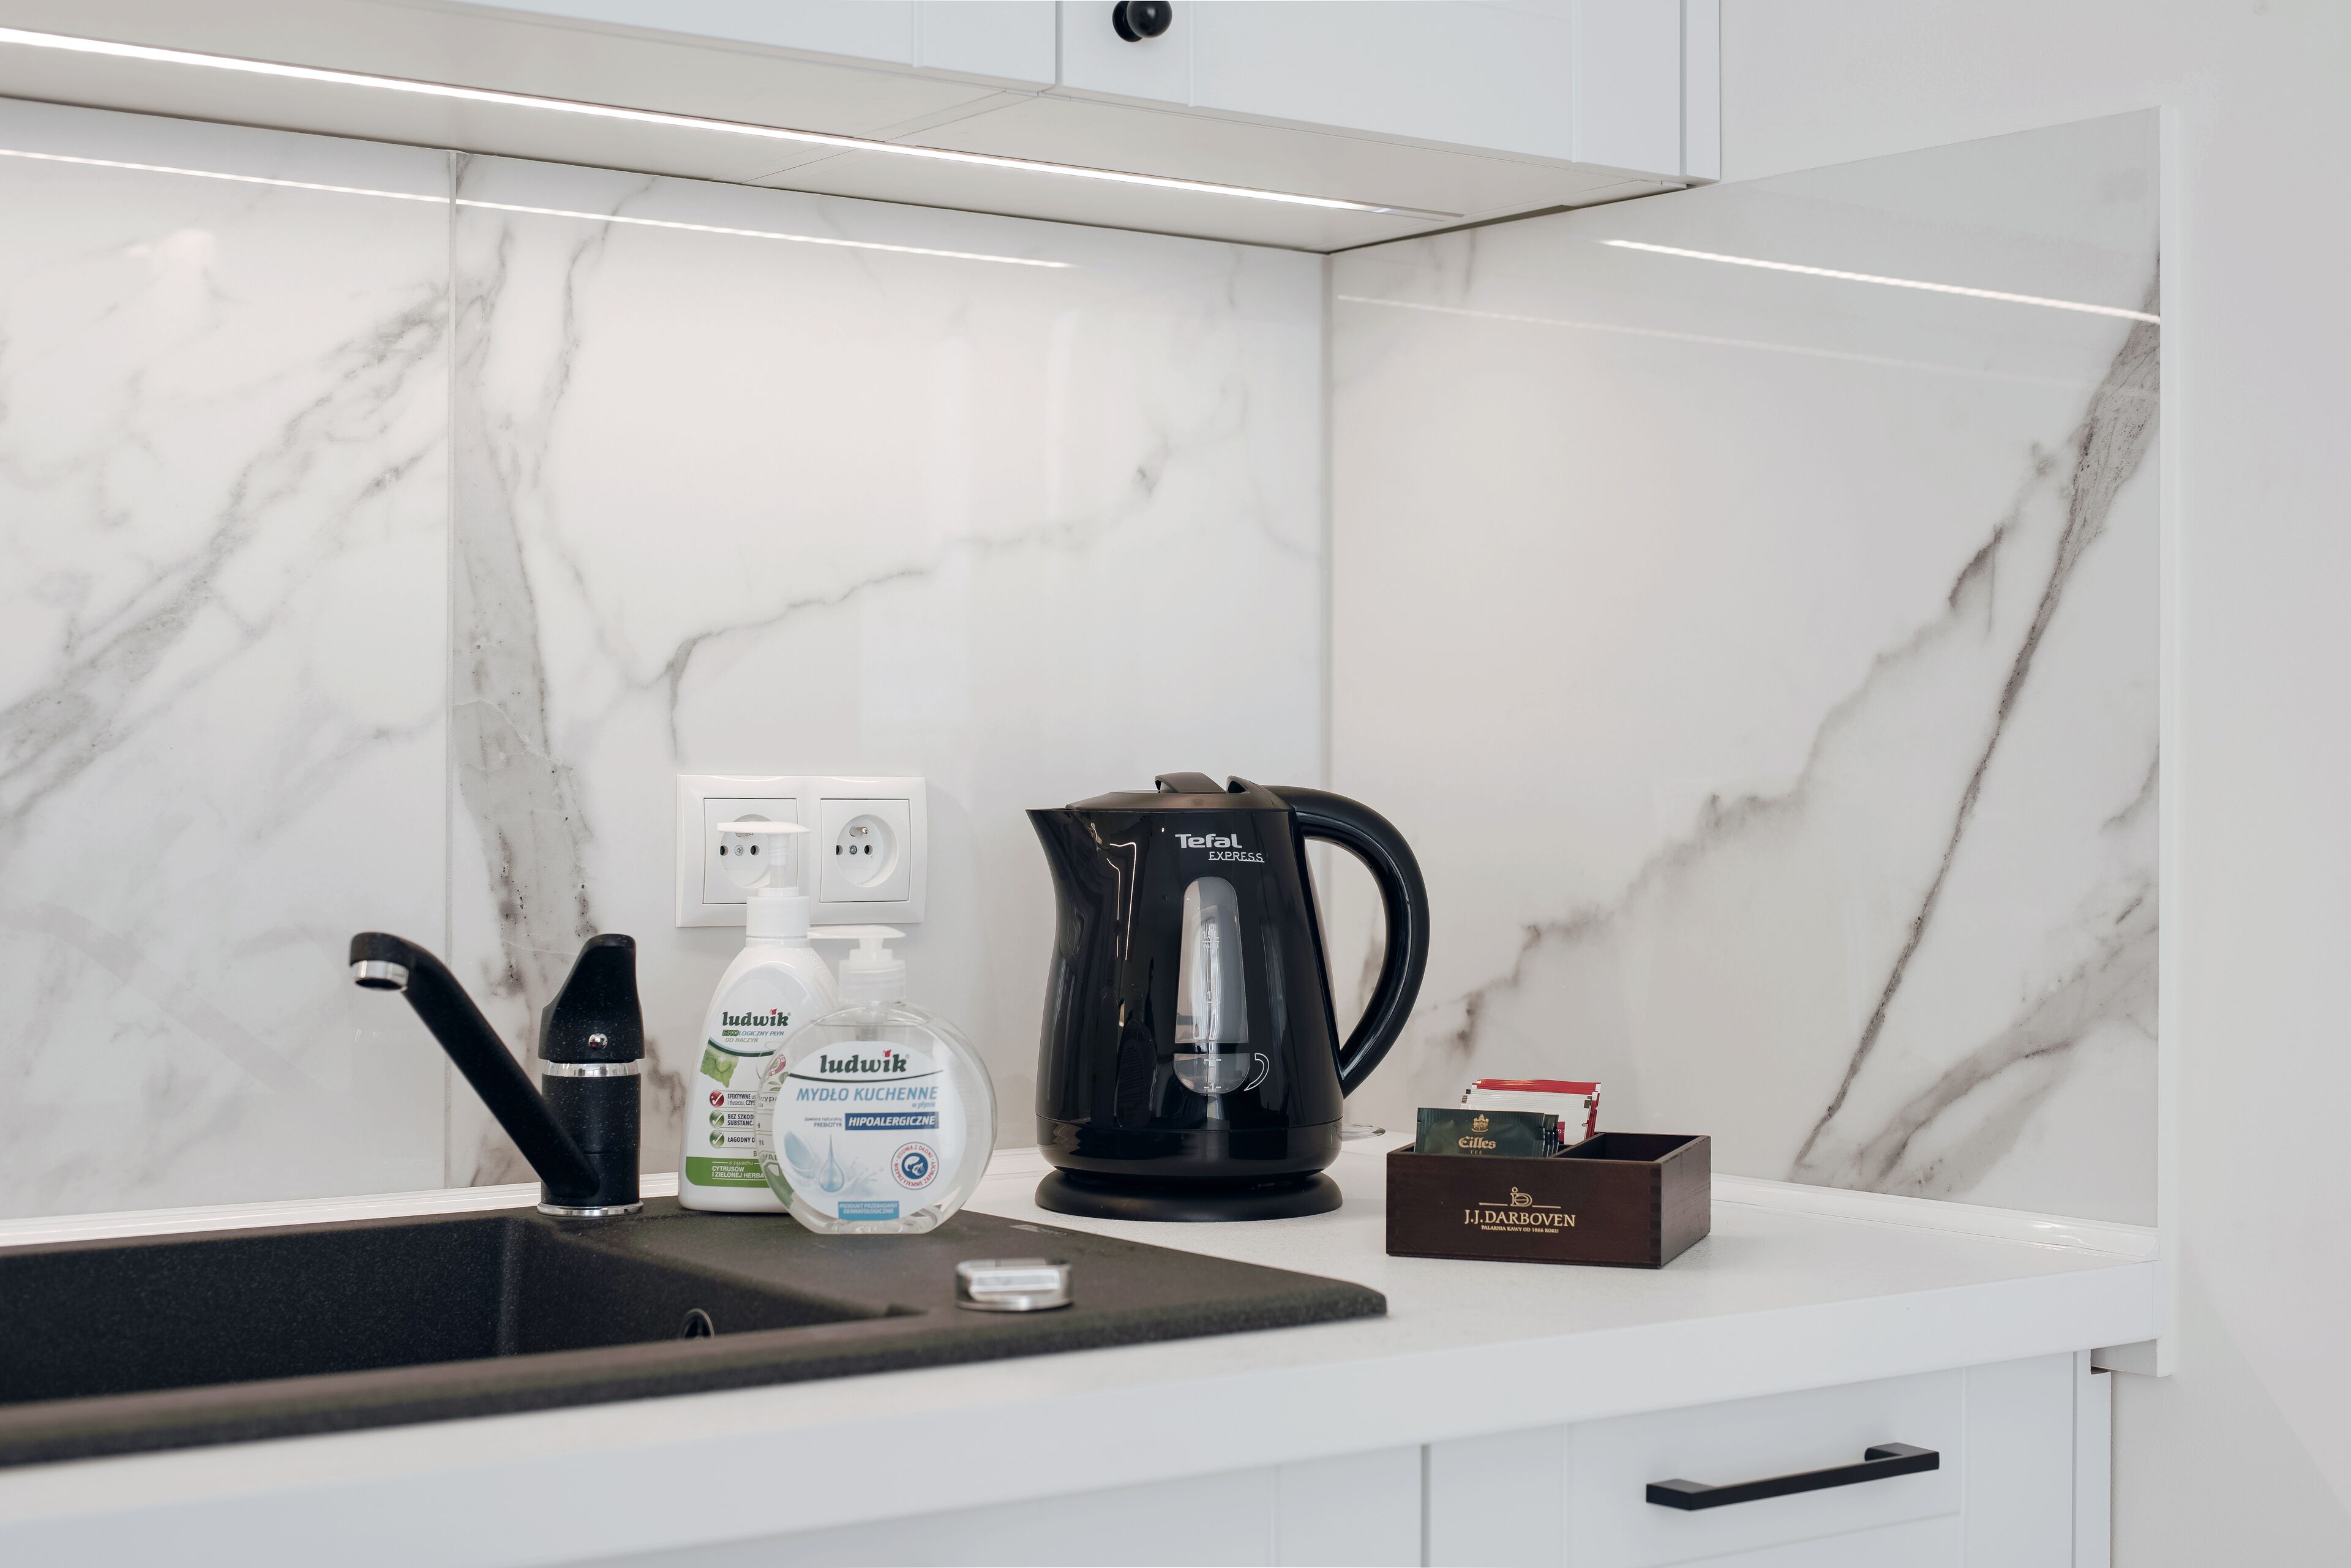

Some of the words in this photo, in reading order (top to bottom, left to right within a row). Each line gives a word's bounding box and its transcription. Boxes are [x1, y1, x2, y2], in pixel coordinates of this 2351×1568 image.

[1175, 833, 1242, 849] Tefal
[1209, 851, 1265, 863] EXPRESS
[722, 1008, 789, 1026] ludwik
[820, 1049, 907, 1073] ludwik
[797, 1088, 849, 1101] MYDŁO
[854, 1087, 939, 1101] KUCHENNE
[848, 1116, 936, 1127] HIPOALERGICZNE
[1458, 1136, 1496, 1149] Eilles
[1464, 1209, 1576, 1227] J.J.DARBOVEN
